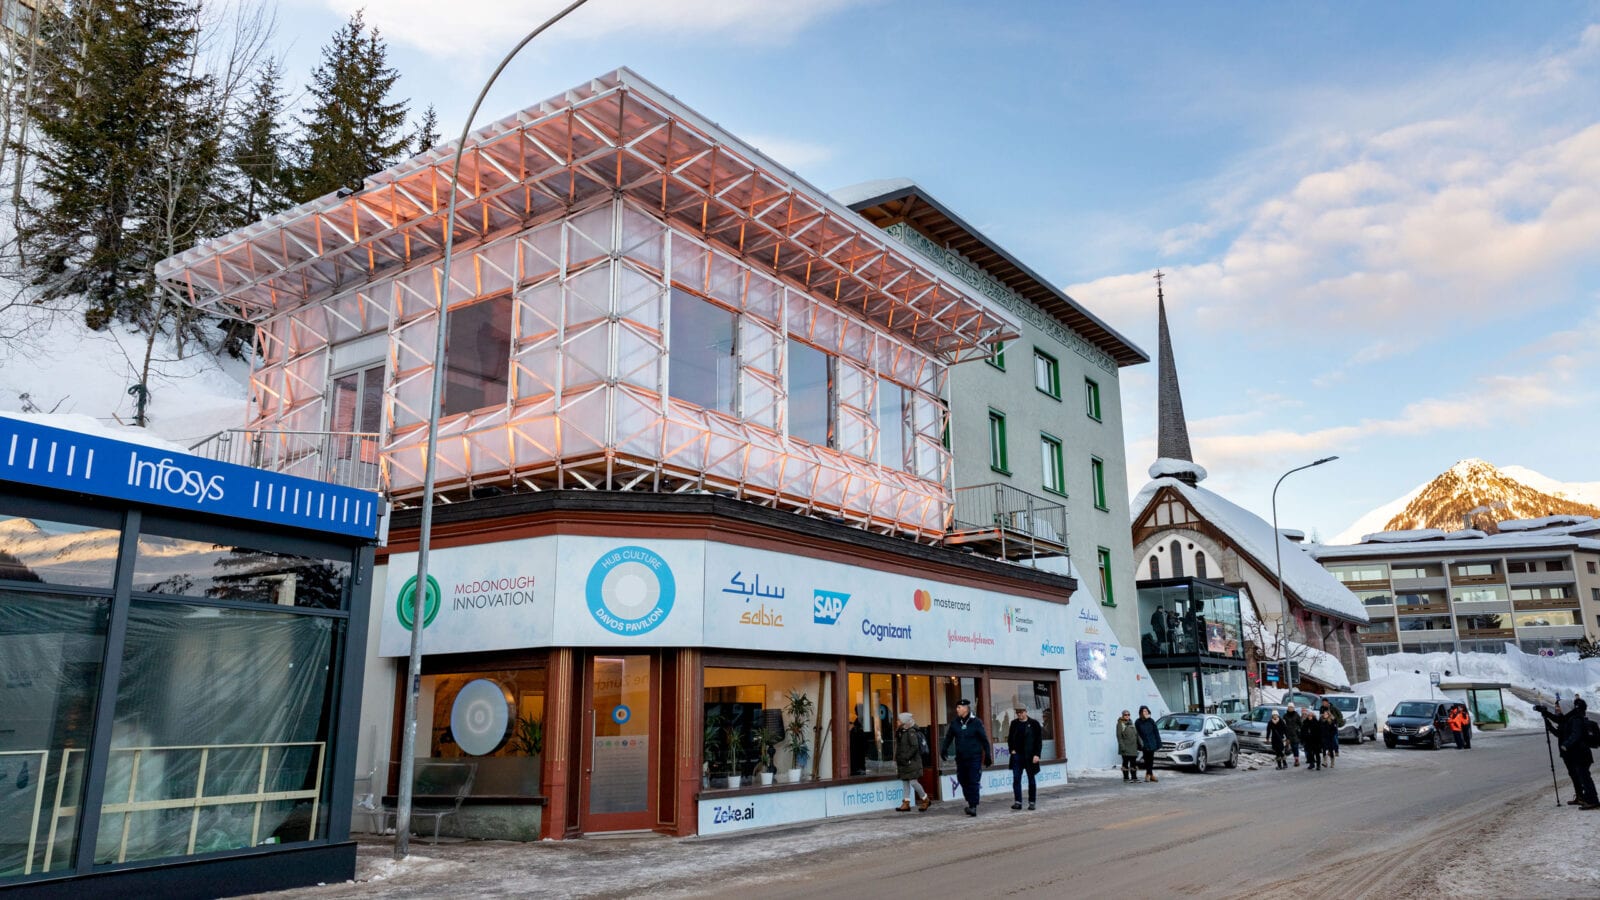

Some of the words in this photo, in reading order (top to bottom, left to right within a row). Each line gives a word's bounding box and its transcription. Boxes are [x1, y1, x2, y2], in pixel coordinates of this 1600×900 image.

[128, 451, 225, 503] Infosys
[601, 553, 621, 569] HUB
[622, 550, 662, 570] CULTURE
[454, 576, 535, 595] McDONOUGH
[722, 571, 785, 603] سابك
[453, 590, 534, 611] INNOVATION
[814, 595, 843, 620] SAP
[933, 597, 971, 612] mastercard
[595, 608, 624, 631] DAVOS
[625, 607, 664, 632] PAVILION
[739, 603, 785, 627] sabic
[861, 618, 912, 642] Cognizant
[1041, 639, 1065, 656] Micron
[842, 790, 855, 806] I'm
[856, 788, 875, 804] here
[876, 788, 884, 802] to
[886, 786, 904, 800] learn
[713, 802, 754, 824] Zeke.ai
